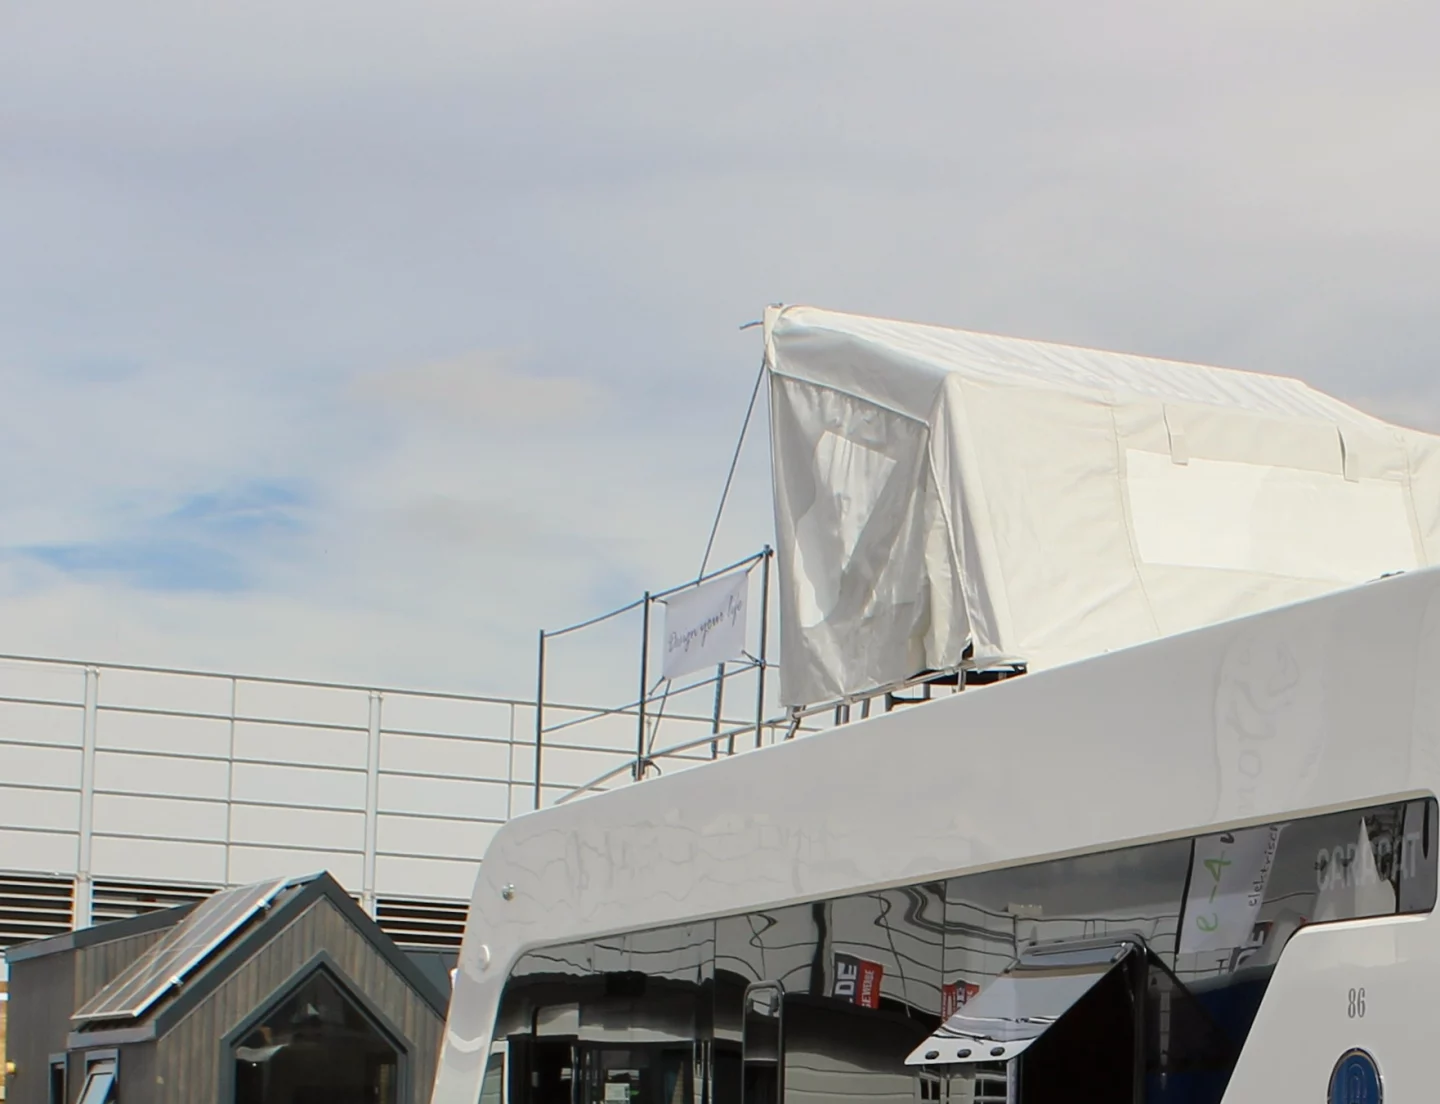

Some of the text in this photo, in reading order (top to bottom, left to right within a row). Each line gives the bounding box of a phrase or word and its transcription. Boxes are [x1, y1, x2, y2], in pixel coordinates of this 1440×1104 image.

[700, 611, 724, 648] your
[727, 592, 742, 628] life
[1316, 831, 1419, 892] CARACAT
[1347, 987, 1366, 1018] 86
